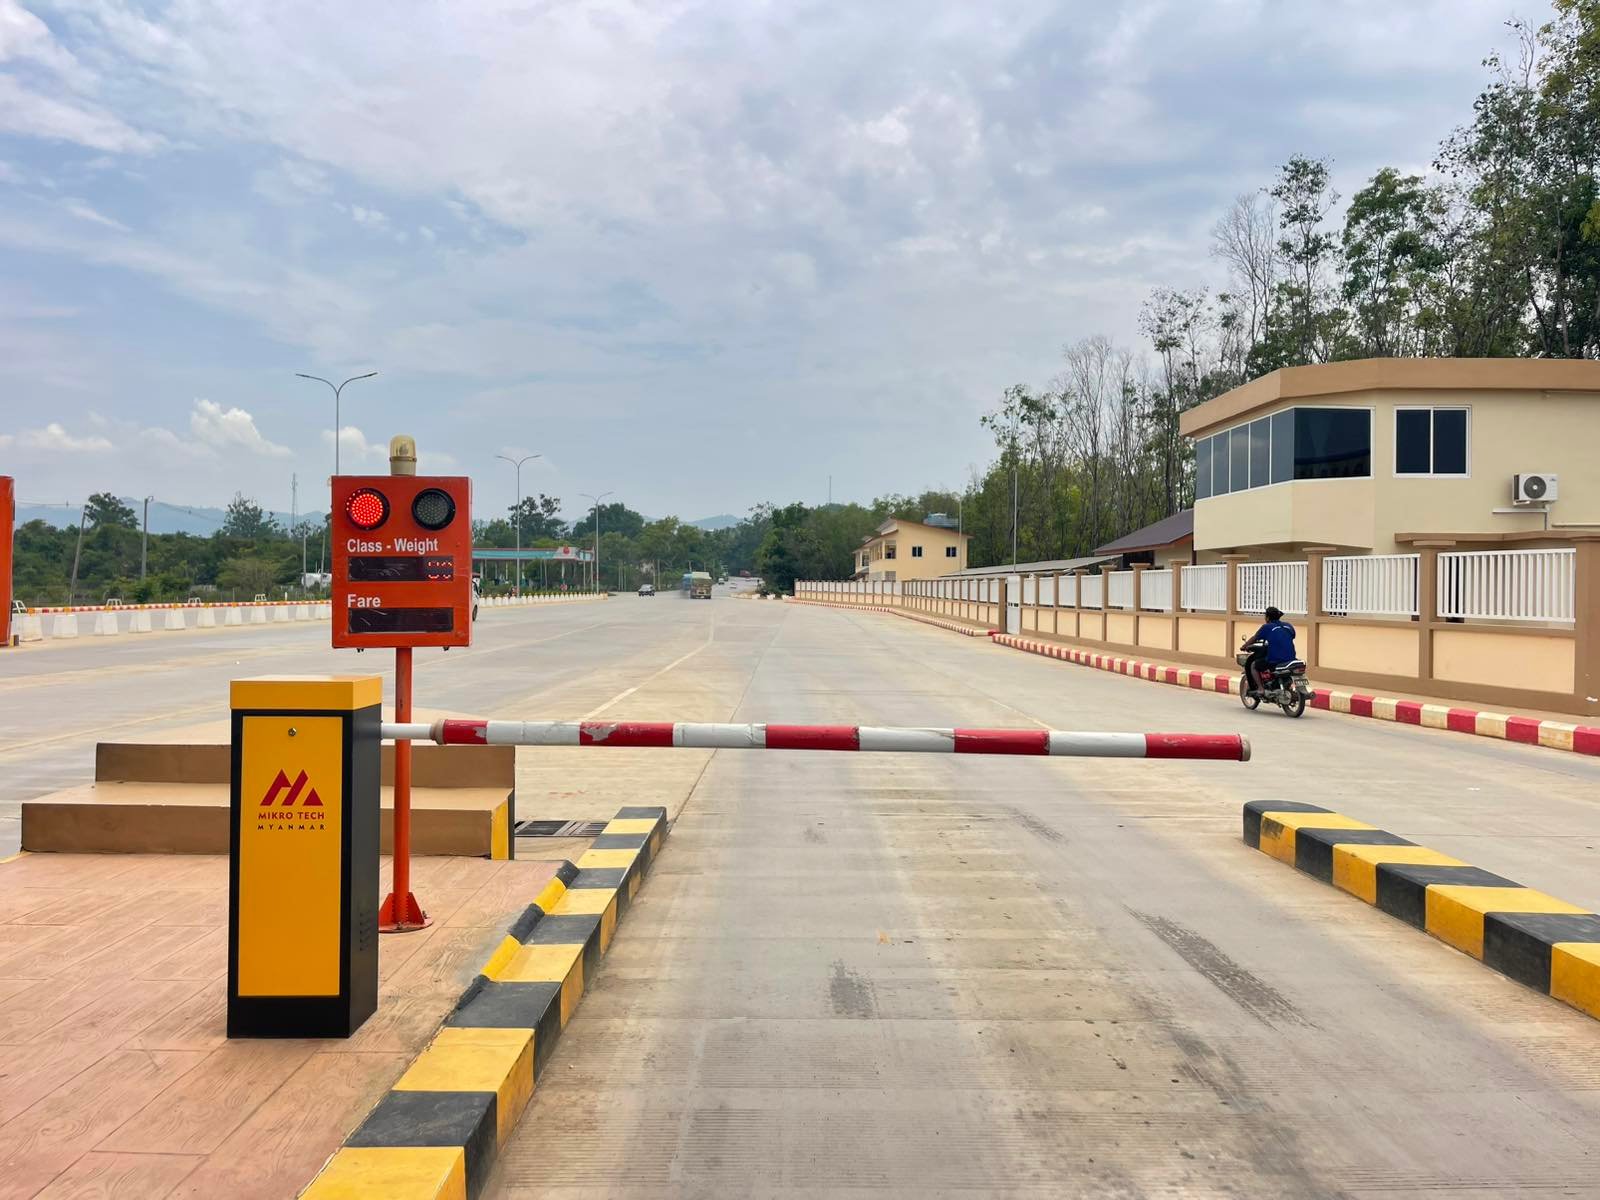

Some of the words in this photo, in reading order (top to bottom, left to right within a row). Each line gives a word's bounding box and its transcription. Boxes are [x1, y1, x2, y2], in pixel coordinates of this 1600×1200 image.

[347, 538, 383, 553] Class
[394, 538, 439, 555] Weight
[347, 593, 382, 608] Fare
[258, 811, 293, 820] MIKRO
[297, 811, 325, 820] TECH
